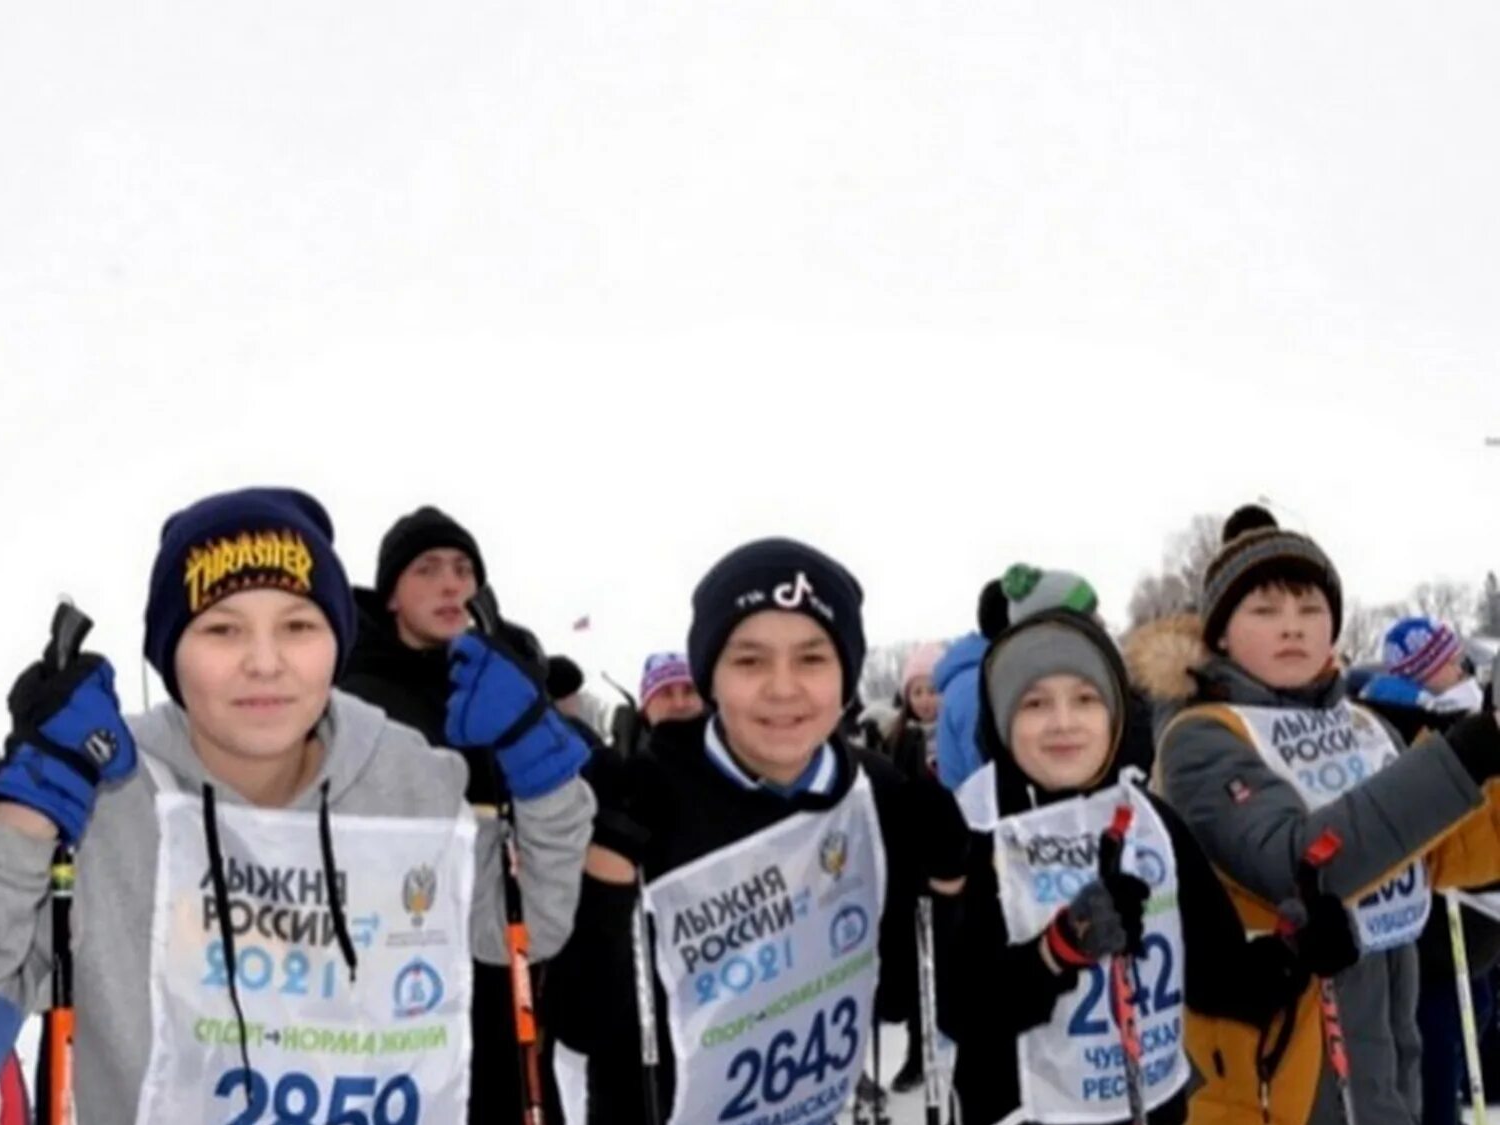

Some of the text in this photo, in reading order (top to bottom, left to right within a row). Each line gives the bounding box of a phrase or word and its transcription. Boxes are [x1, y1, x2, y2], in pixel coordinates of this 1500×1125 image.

[184, 530, 313, 612] THRASHER
[1272, 704, 1350, 746] ЛЫЖН
[1297, 754, 1365, 793] 202
[203, 894, 347, 947] РОССИИ
[673, 865, 787, 946] ЛЫЖНЯ
[680, 895, 794, 974] РОССИИ
[200, 940, 335, 999] 2021
[695, 934, 793, 1006] 2021
[1068, 931, 1181, 1037] 242
[193, 1017, 264, 1047] СПОРТ
[283, 1024, 375, 1054] НОРМА
[718, 995, 858, 1122] 2643
